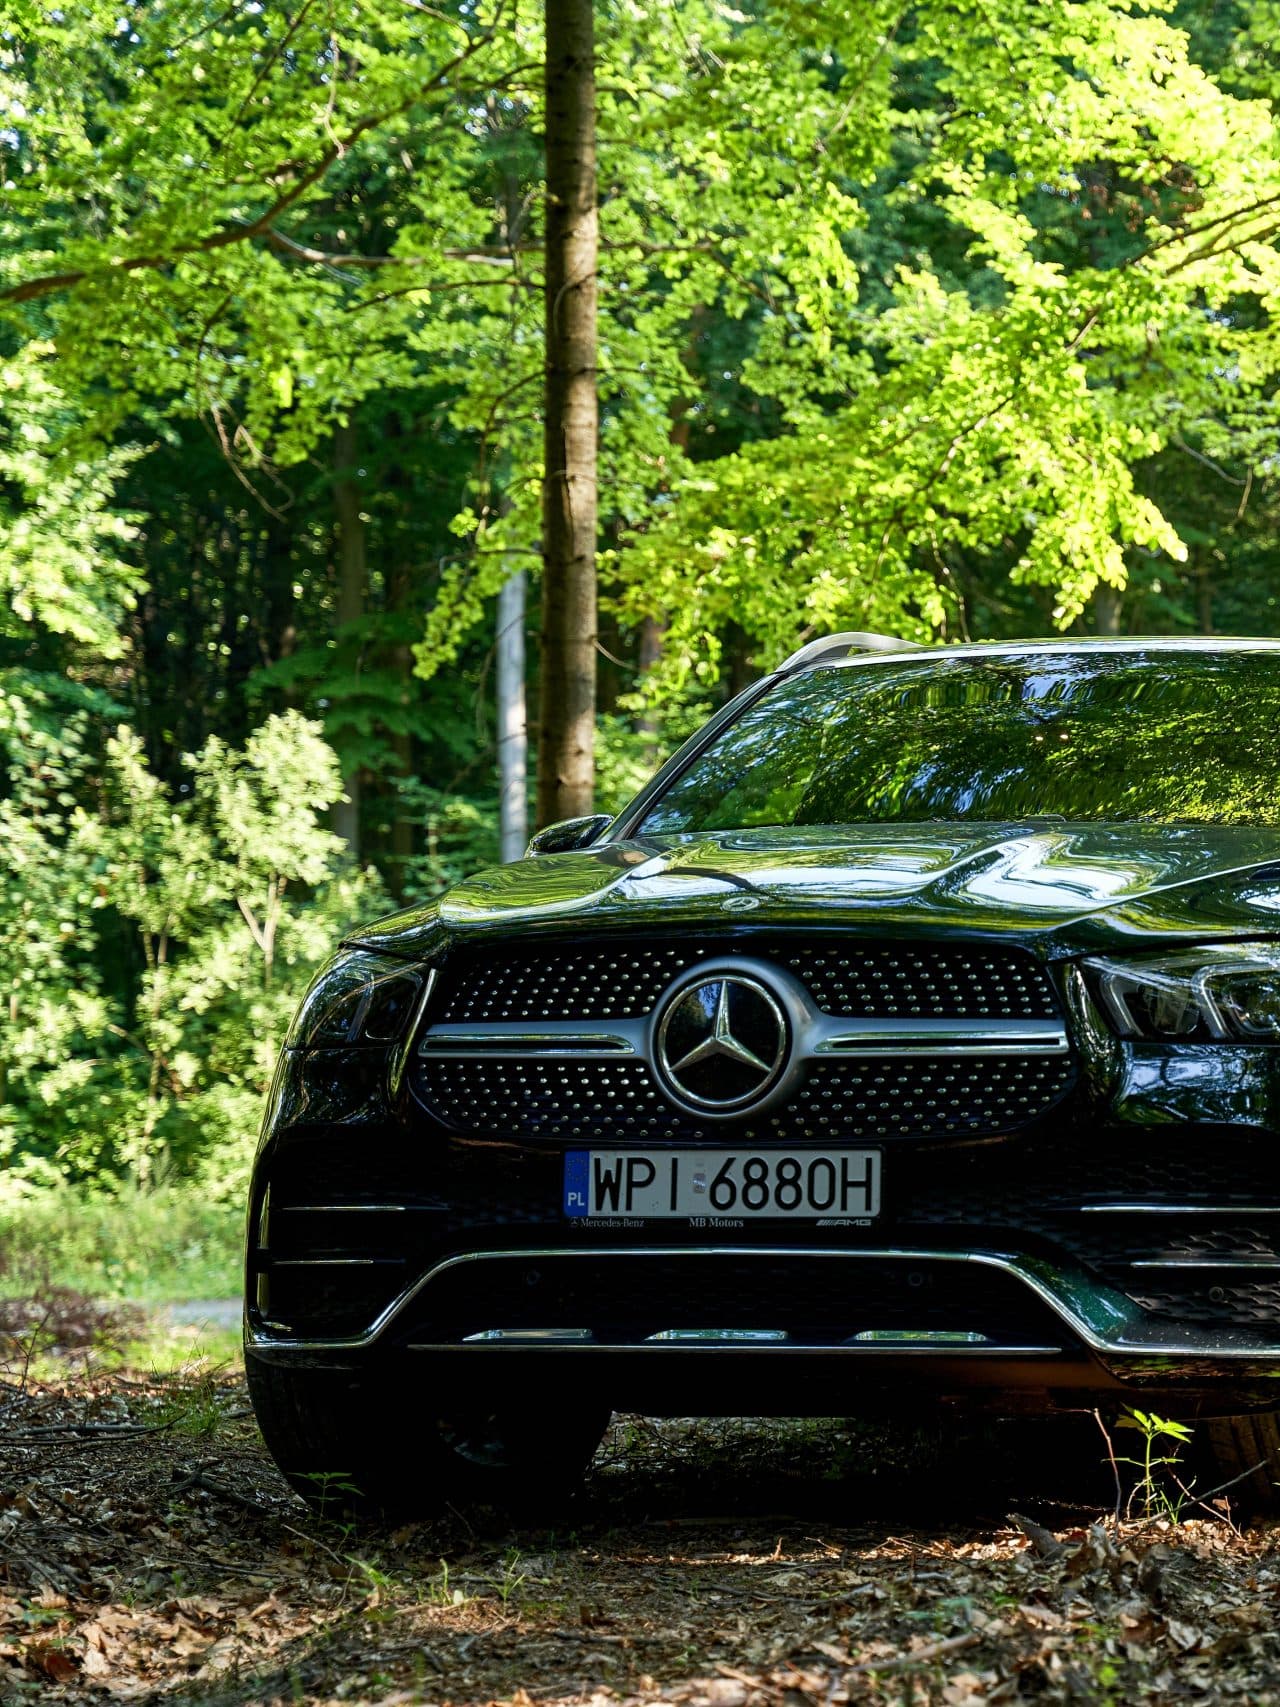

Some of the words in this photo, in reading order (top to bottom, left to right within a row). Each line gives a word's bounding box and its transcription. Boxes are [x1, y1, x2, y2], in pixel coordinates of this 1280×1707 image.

[567, 1191, 586, 1207] PL
[581, 1217, 645, 1228] Mercedes-Benz
[689, 1217, 707, 1228] MB
[709, 1217, 744, 1228] Motors
